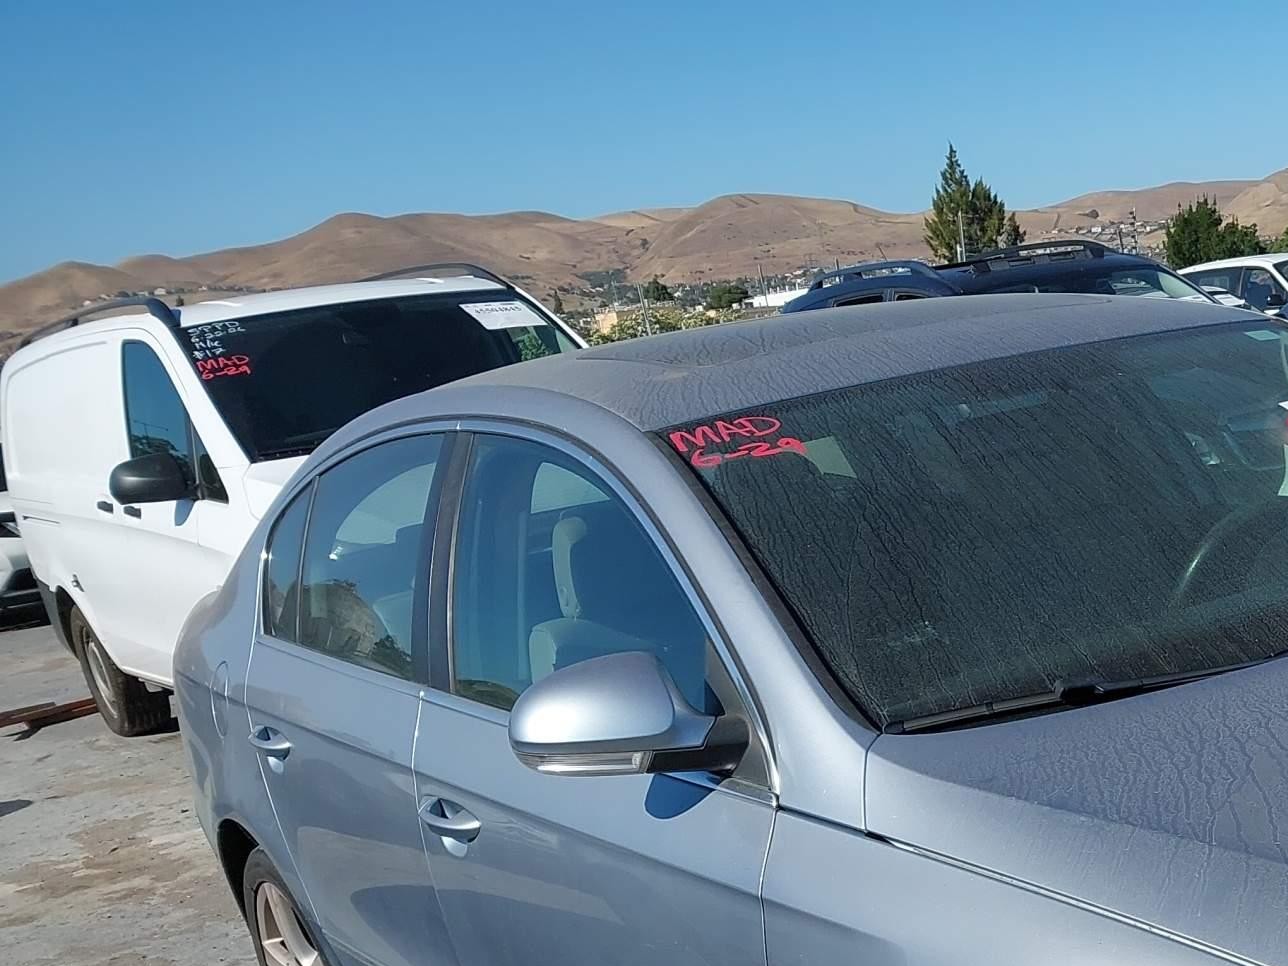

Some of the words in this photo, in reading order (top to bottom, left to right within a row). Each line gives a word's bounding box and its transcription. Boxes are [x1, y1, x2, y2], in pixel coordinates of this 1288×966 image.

[196, 355, 249, 371] MAD
[670, 416, 781, 452] MAD
[691, 437, 807, 467] 6-29
